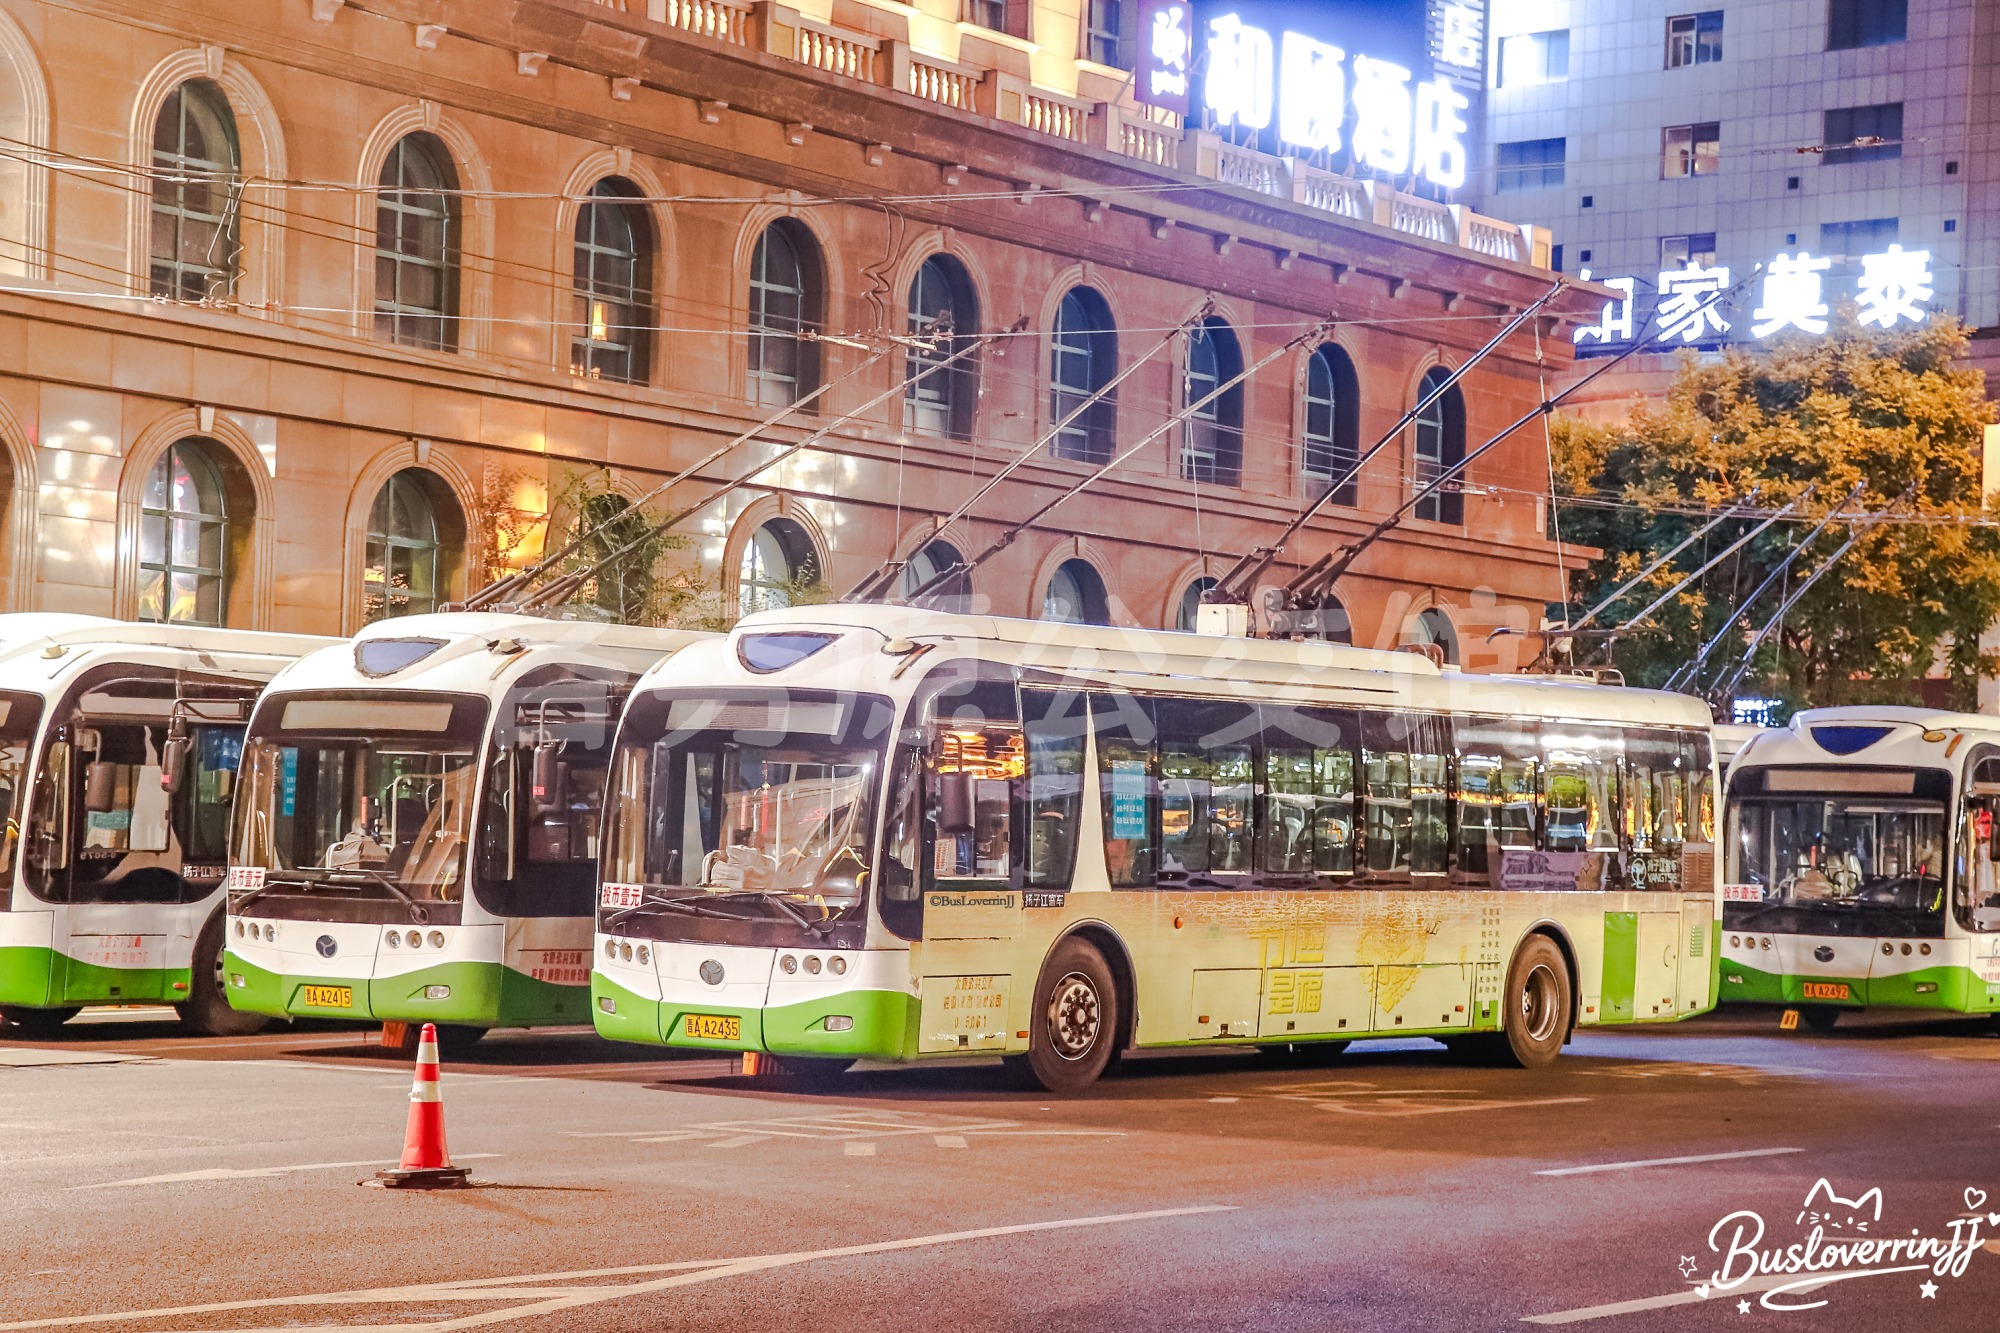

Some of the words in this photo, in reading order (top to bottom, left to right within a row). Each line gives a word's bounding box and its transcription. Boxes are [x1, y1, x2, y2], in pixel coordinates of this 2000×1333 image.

[230, 868, 264, 888] 投币壹元
[602, 885, 640, 907] 投币壹元
[1024, 893, 1065, 908] 扬子江客车
